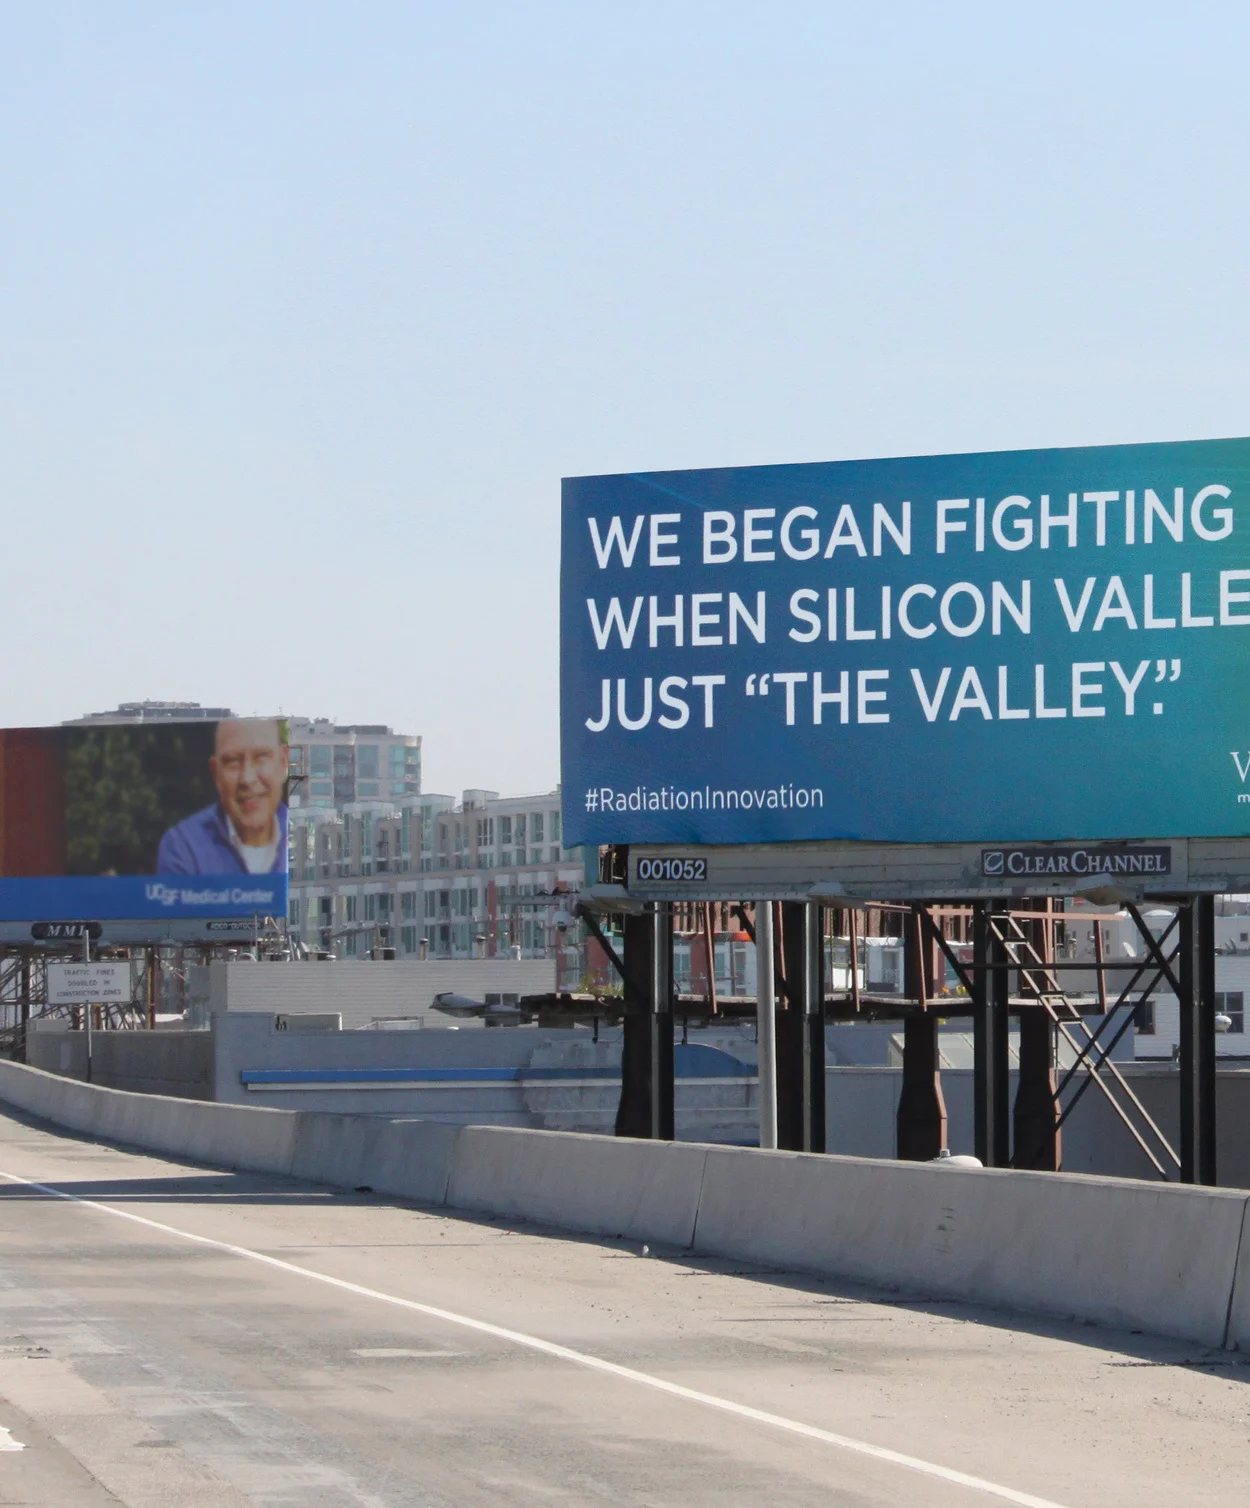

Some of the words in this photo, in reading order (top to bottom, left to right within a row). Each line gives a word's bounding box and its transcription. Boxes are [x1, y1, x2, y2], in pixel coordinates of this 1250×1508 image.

[587, 512, 681, 569] WE
[703, 501, 912, 565] BEGAN
[936, 484, 1234, 554] FIGHTING
[587, 590, 766, 650] WHEN
[789, 579, 1031, 643] SILICON
[585, 674, 726, 733] JUST
[746, 669, 890, 726] “THE
[585, 784, 824, 812] #RadiationInnovation
[639, 859, 705, 880] 001052
